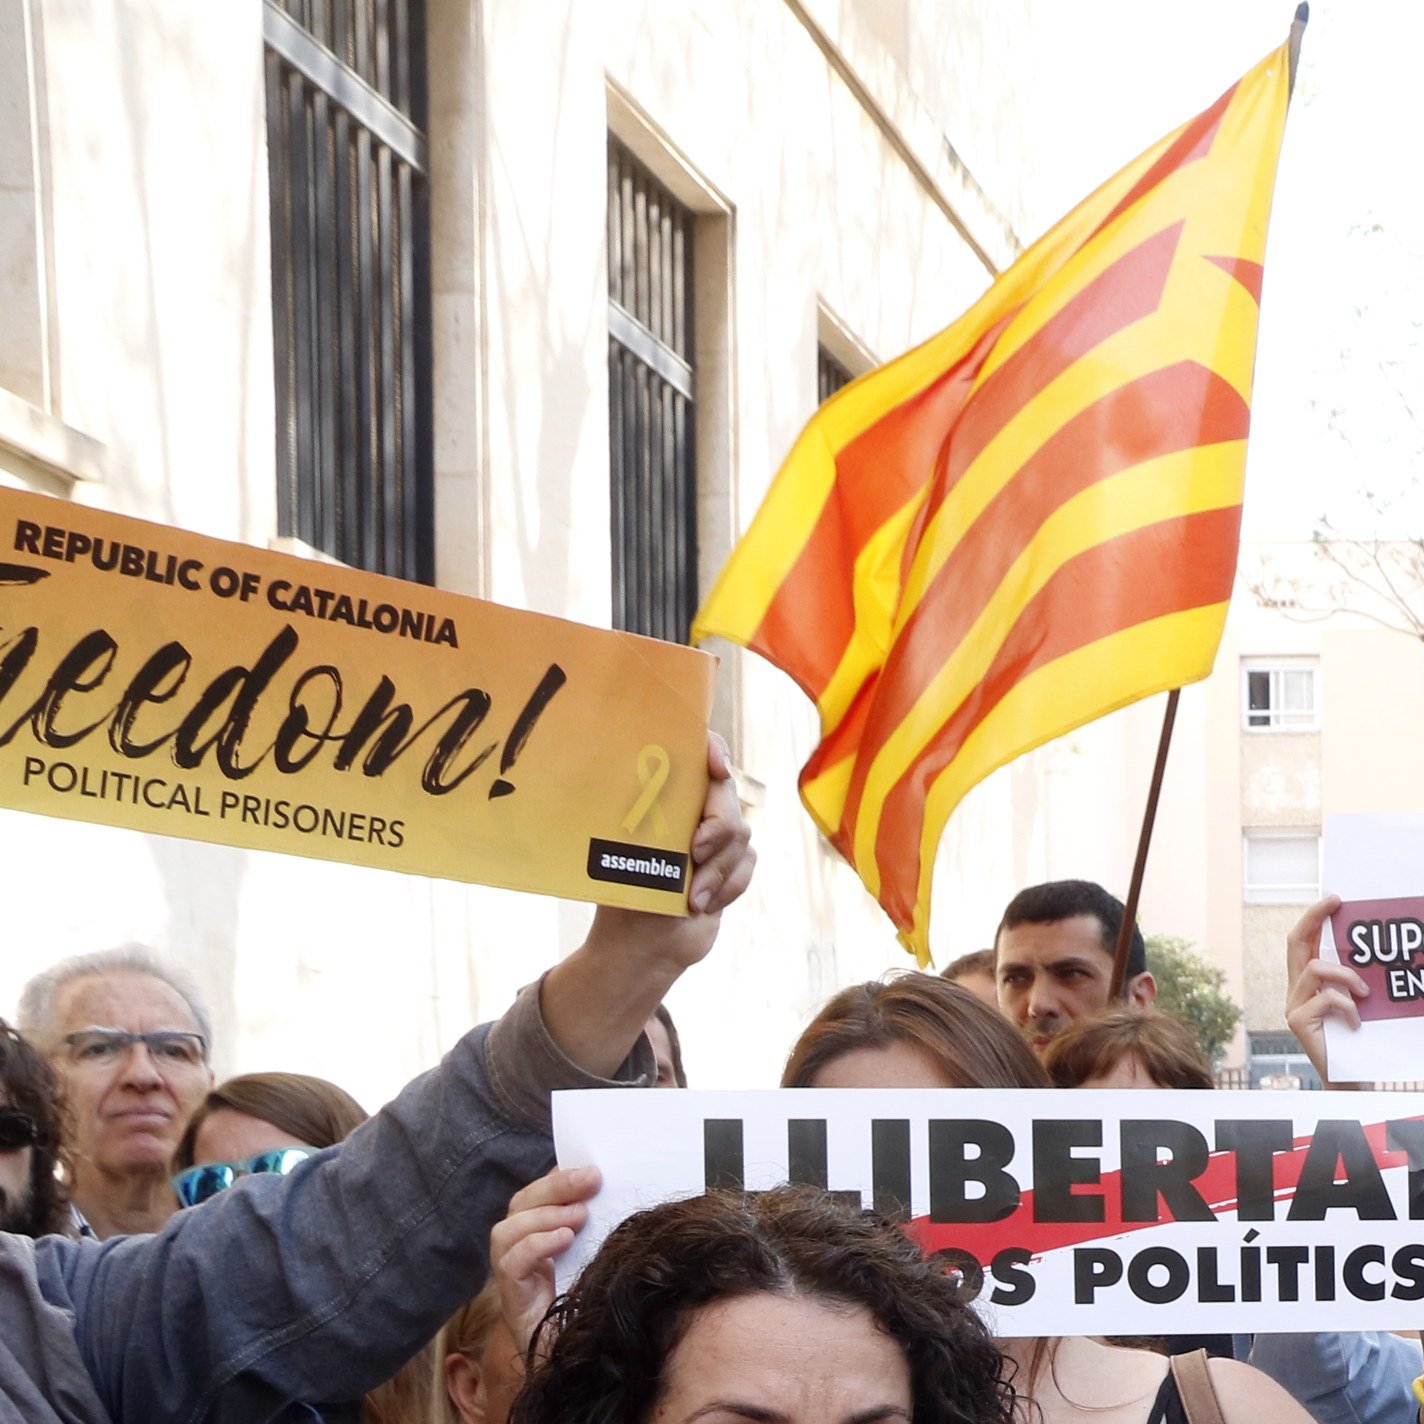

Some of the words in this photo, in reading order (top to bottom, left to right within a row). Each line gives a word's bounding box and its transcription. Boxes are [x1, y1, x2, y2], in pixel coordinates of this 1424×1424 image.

[14, 520, 204, 592] REPUBLIC
[210, 564, 259, 603] OF
[267, 579, 459, 649] CATALONIA
[23, 756, 210, 817] POLITICAL
[220, 794, 406, 849] PRISONERS
[601, 854, 681, 880] assemblea
[942, 1247, 1037, 1306] OS
